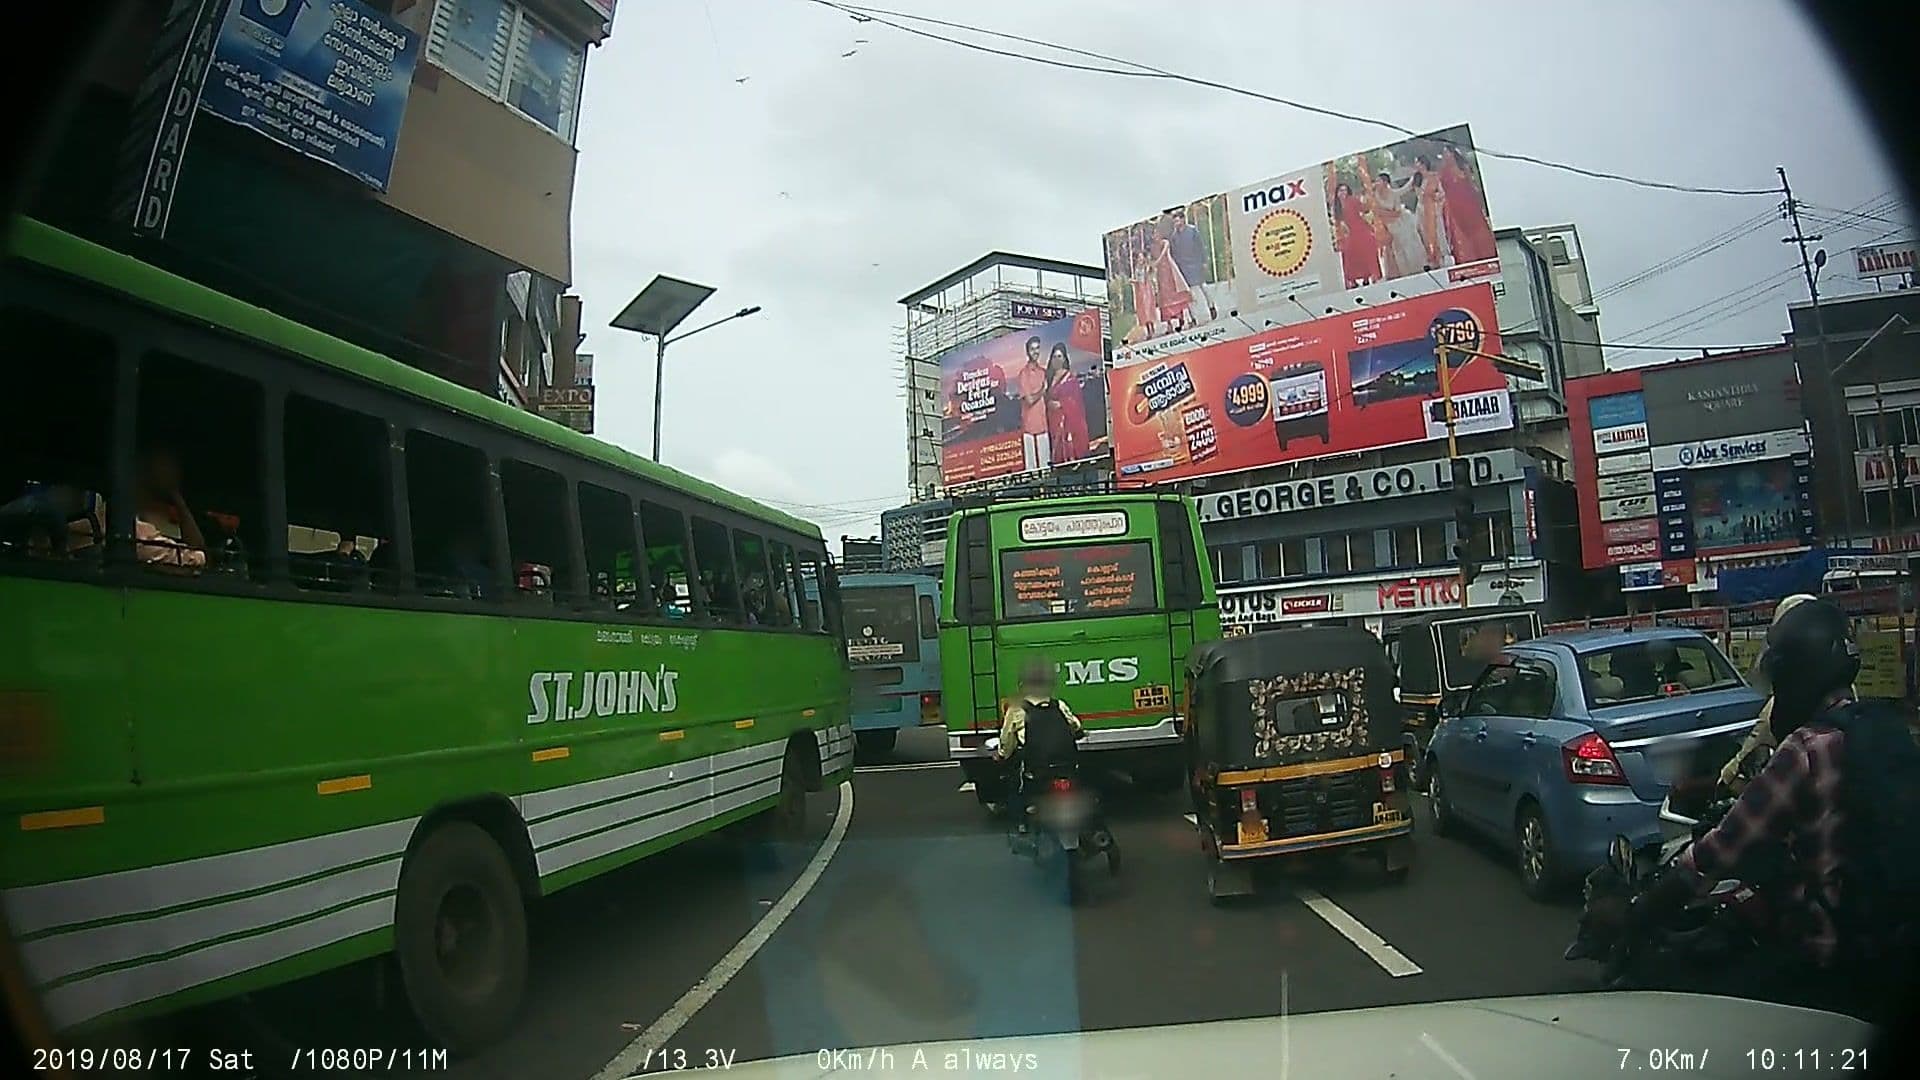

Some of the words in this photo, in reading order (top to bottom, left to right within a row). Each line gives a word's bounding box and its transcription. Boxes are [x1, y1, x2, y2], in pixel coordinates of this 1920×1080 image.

[1243, 179, 1307, 212] max
[543, 389, 592, 402] EXPO
[957, 376, 992, 395] Designs
[961, 397, 996, 413] Occasion
[1217, 478, 1335, 519] GEORGE
[1345, 476, 1364, 501] &
[1373, 467, 1427, 497] CO.
[1436, 456, 1505, 490] LD.
[1219, 591, 1277, 613] OTUS
[1377, 579, 1461, 610] METRO
[1056, 657, 1139, 685] MS
